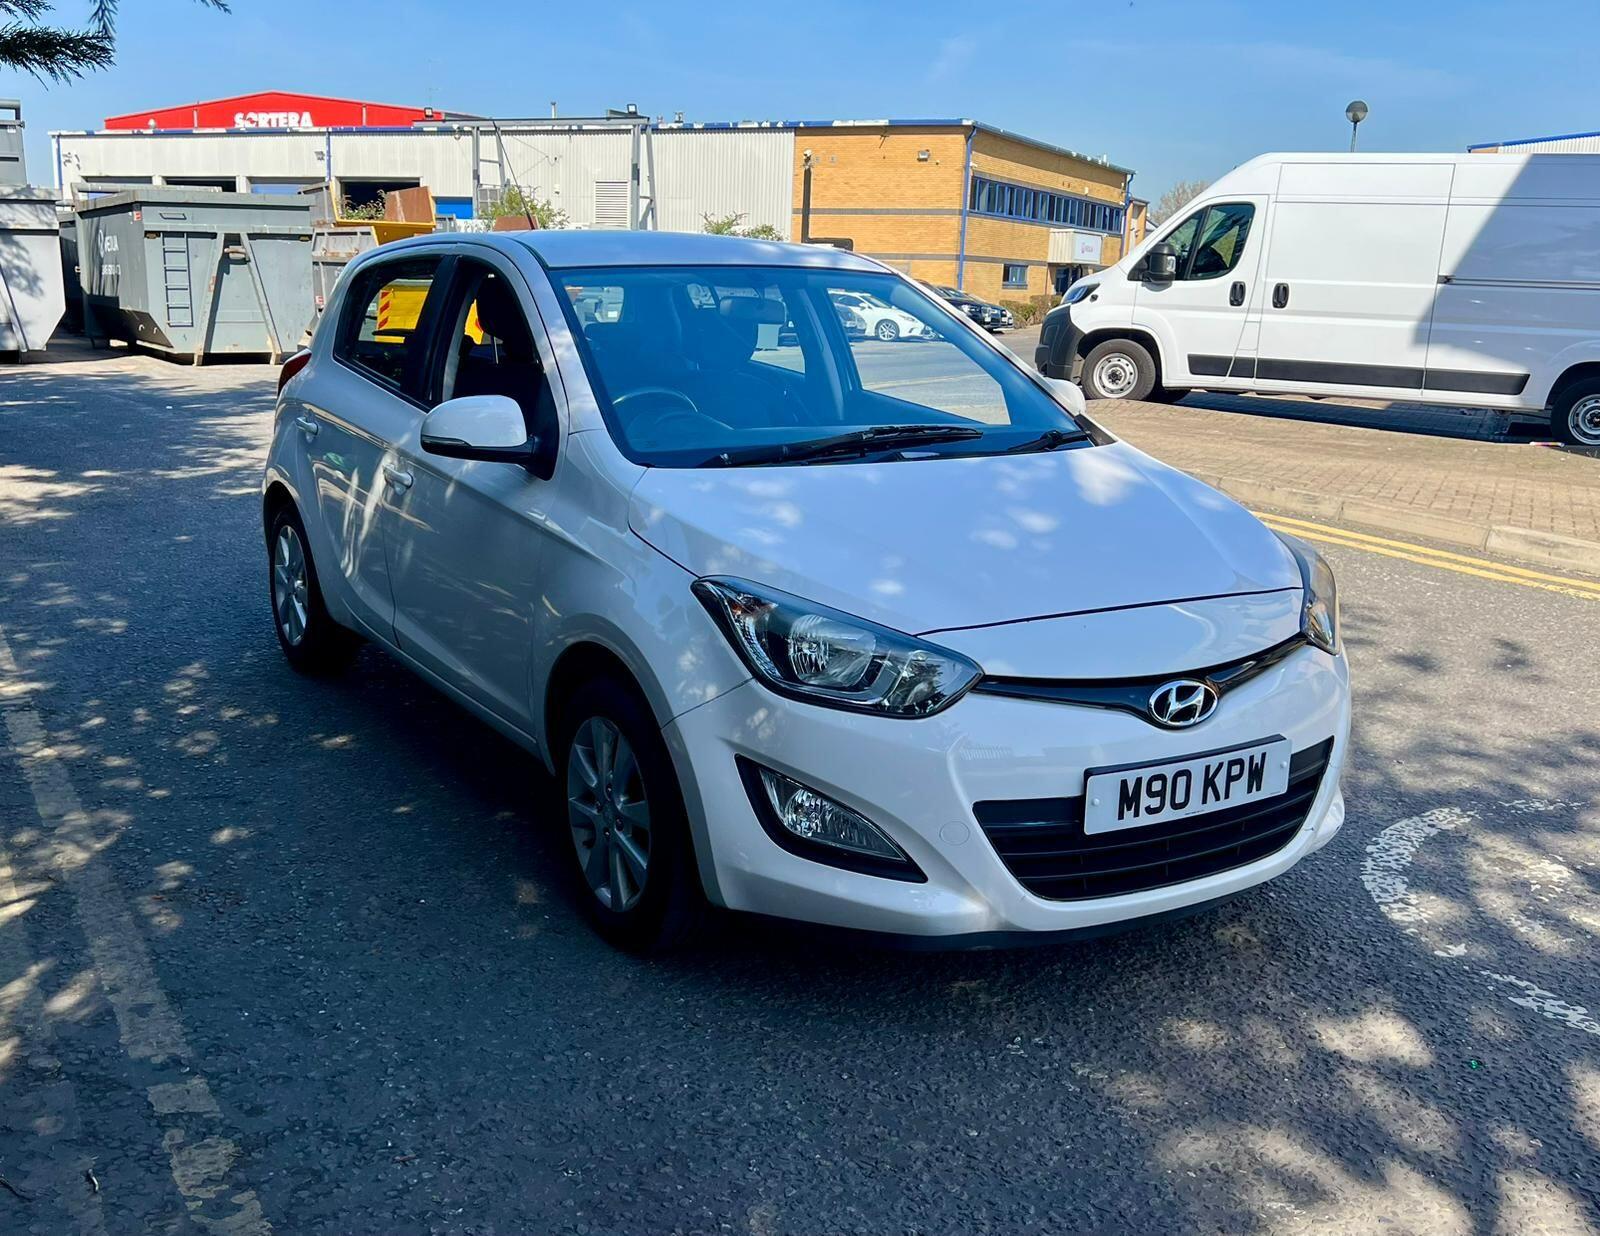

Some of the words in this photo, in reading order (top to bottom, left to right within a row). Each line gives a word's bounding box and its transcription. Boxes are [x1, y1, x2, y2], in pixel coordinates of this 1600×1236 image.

[234, 111, 313, 128] SORTERA
[1117, 769, 1192, 821] M90
[1201, 752, 1267, 805] KPW
